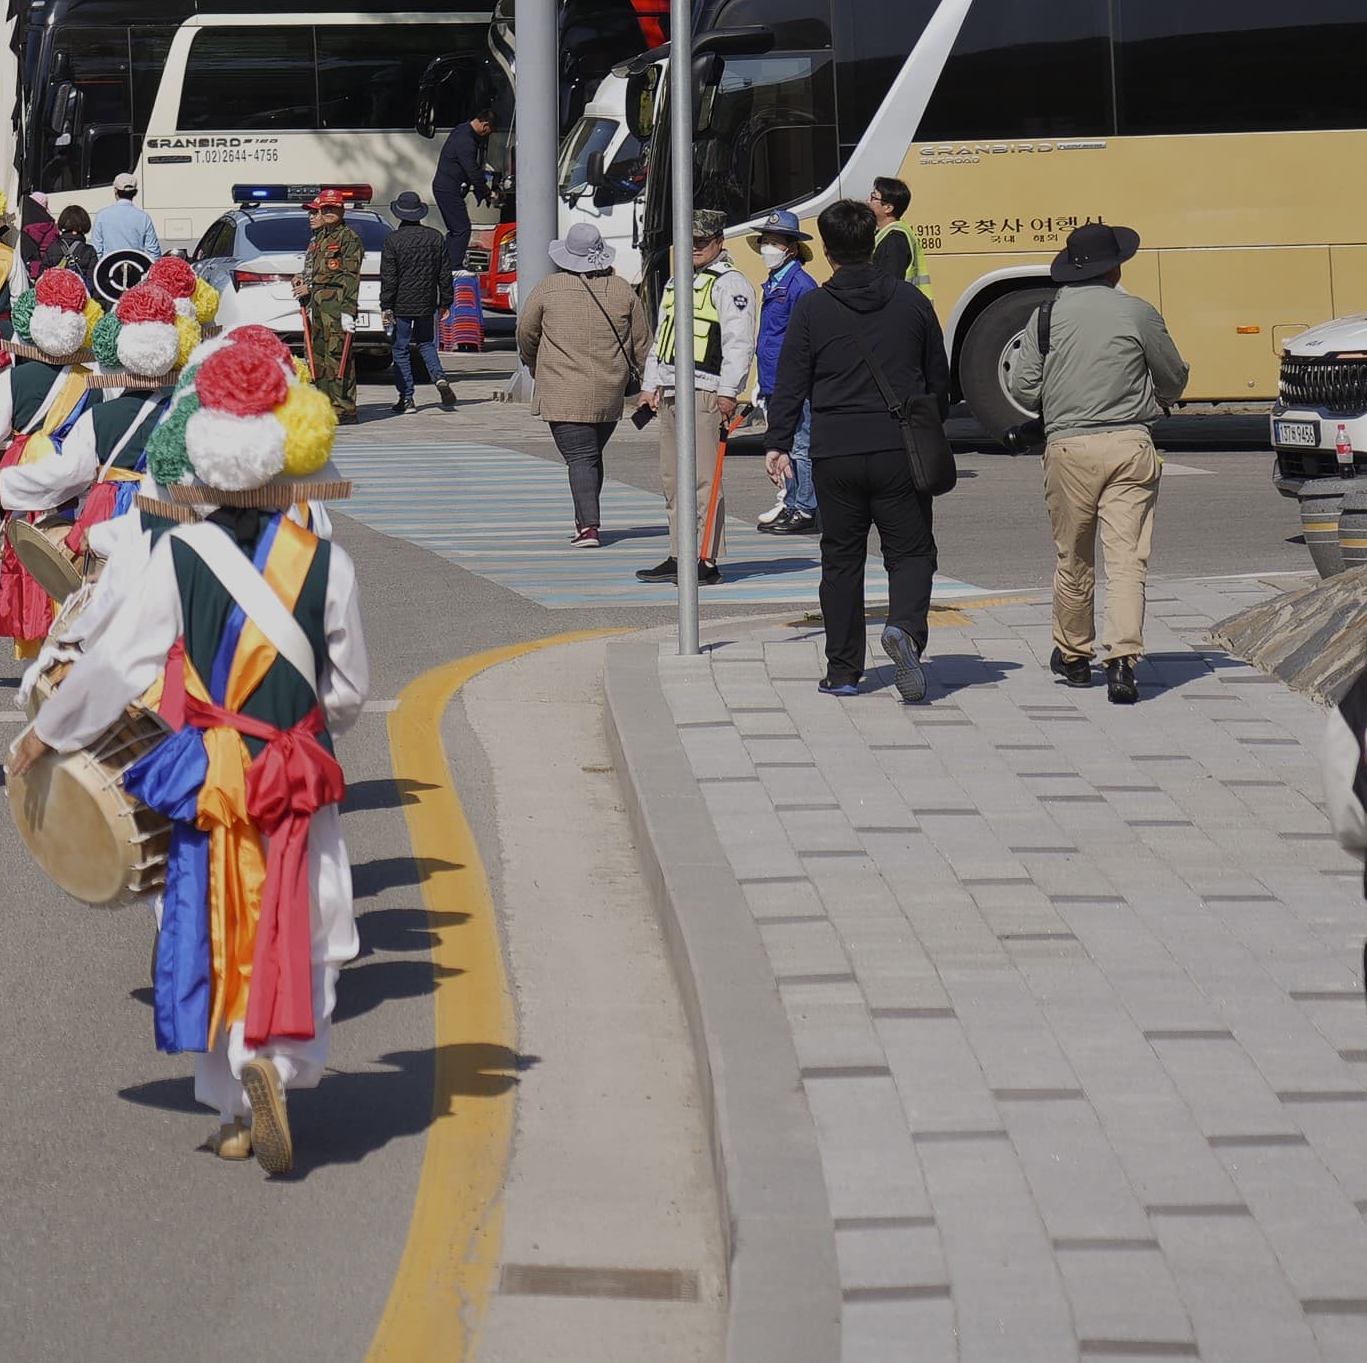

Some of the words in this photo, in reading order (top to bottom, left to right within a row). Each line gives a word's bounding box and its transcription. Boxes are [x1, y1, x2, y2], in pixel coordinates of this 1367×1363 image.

[147, 138, 241, 148] GRANBIRD
[919, 142, 1054, 156] GRANBIRD
[949, 218, 1024, 236] 웃찾사
